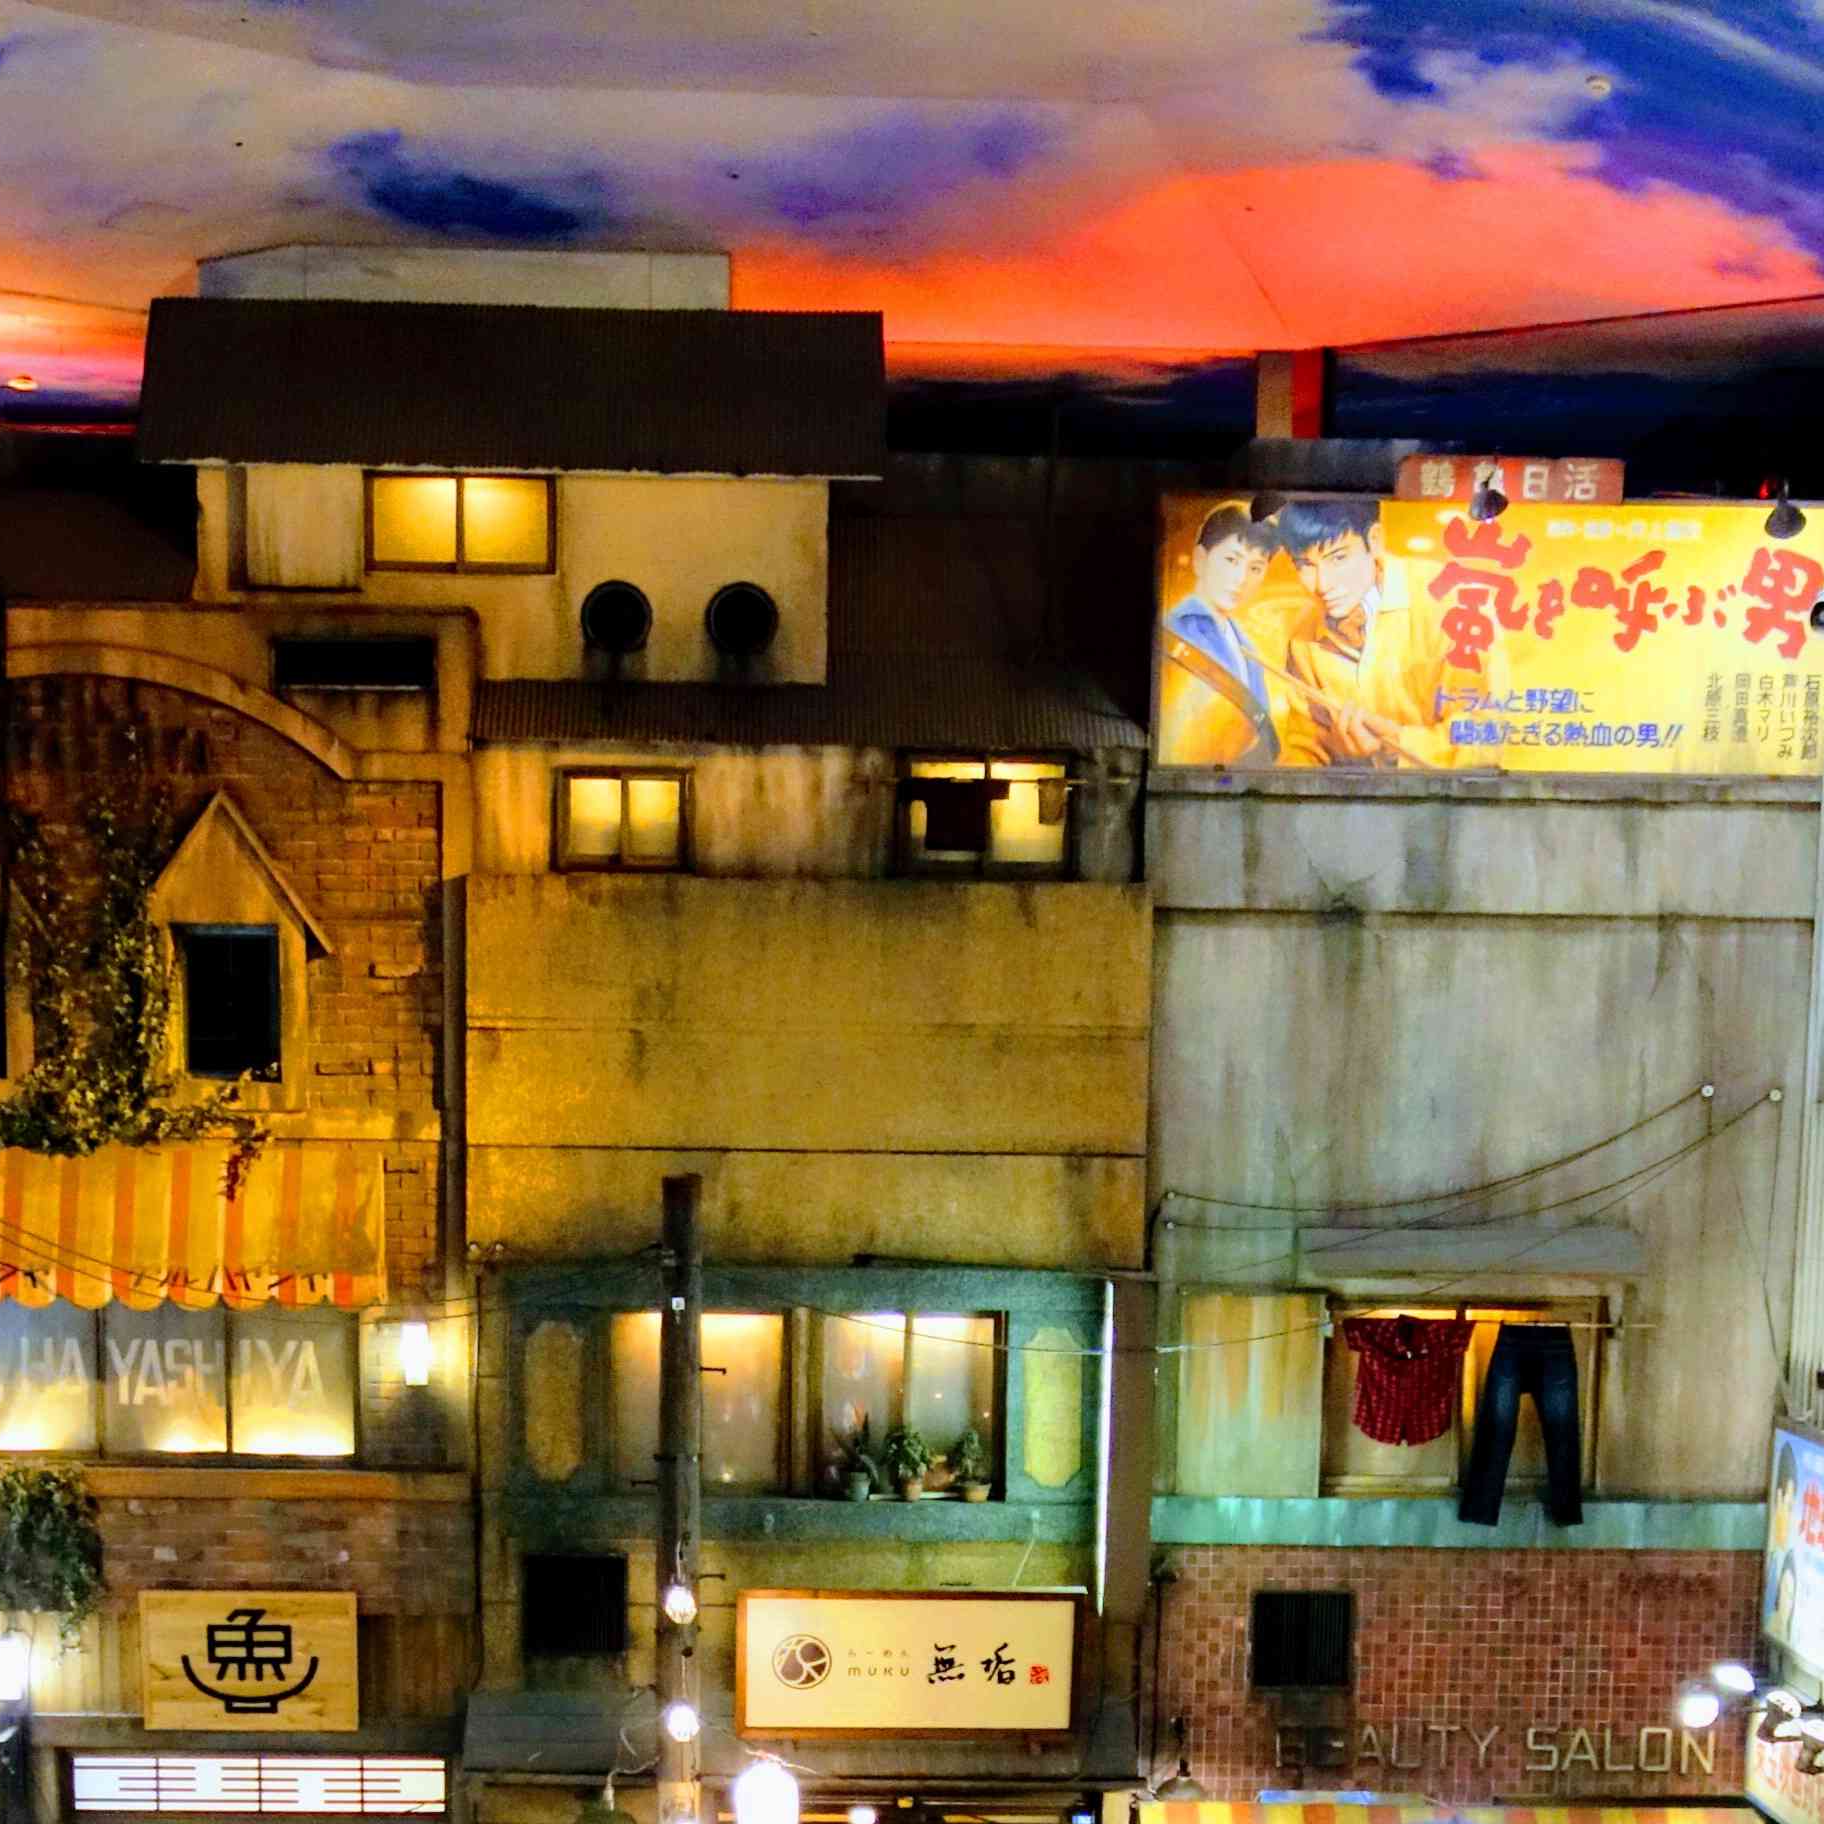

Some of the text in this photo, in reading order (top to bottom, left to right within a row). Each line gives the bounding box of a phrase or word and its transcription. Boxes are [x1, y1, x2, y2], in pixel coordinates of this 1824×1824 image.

[207, 1608, 293, 1682] 魚
[927, 1642, 1017, 1686] 無垢
[1275, 1724, 1716, 1774] AUTY SALON
